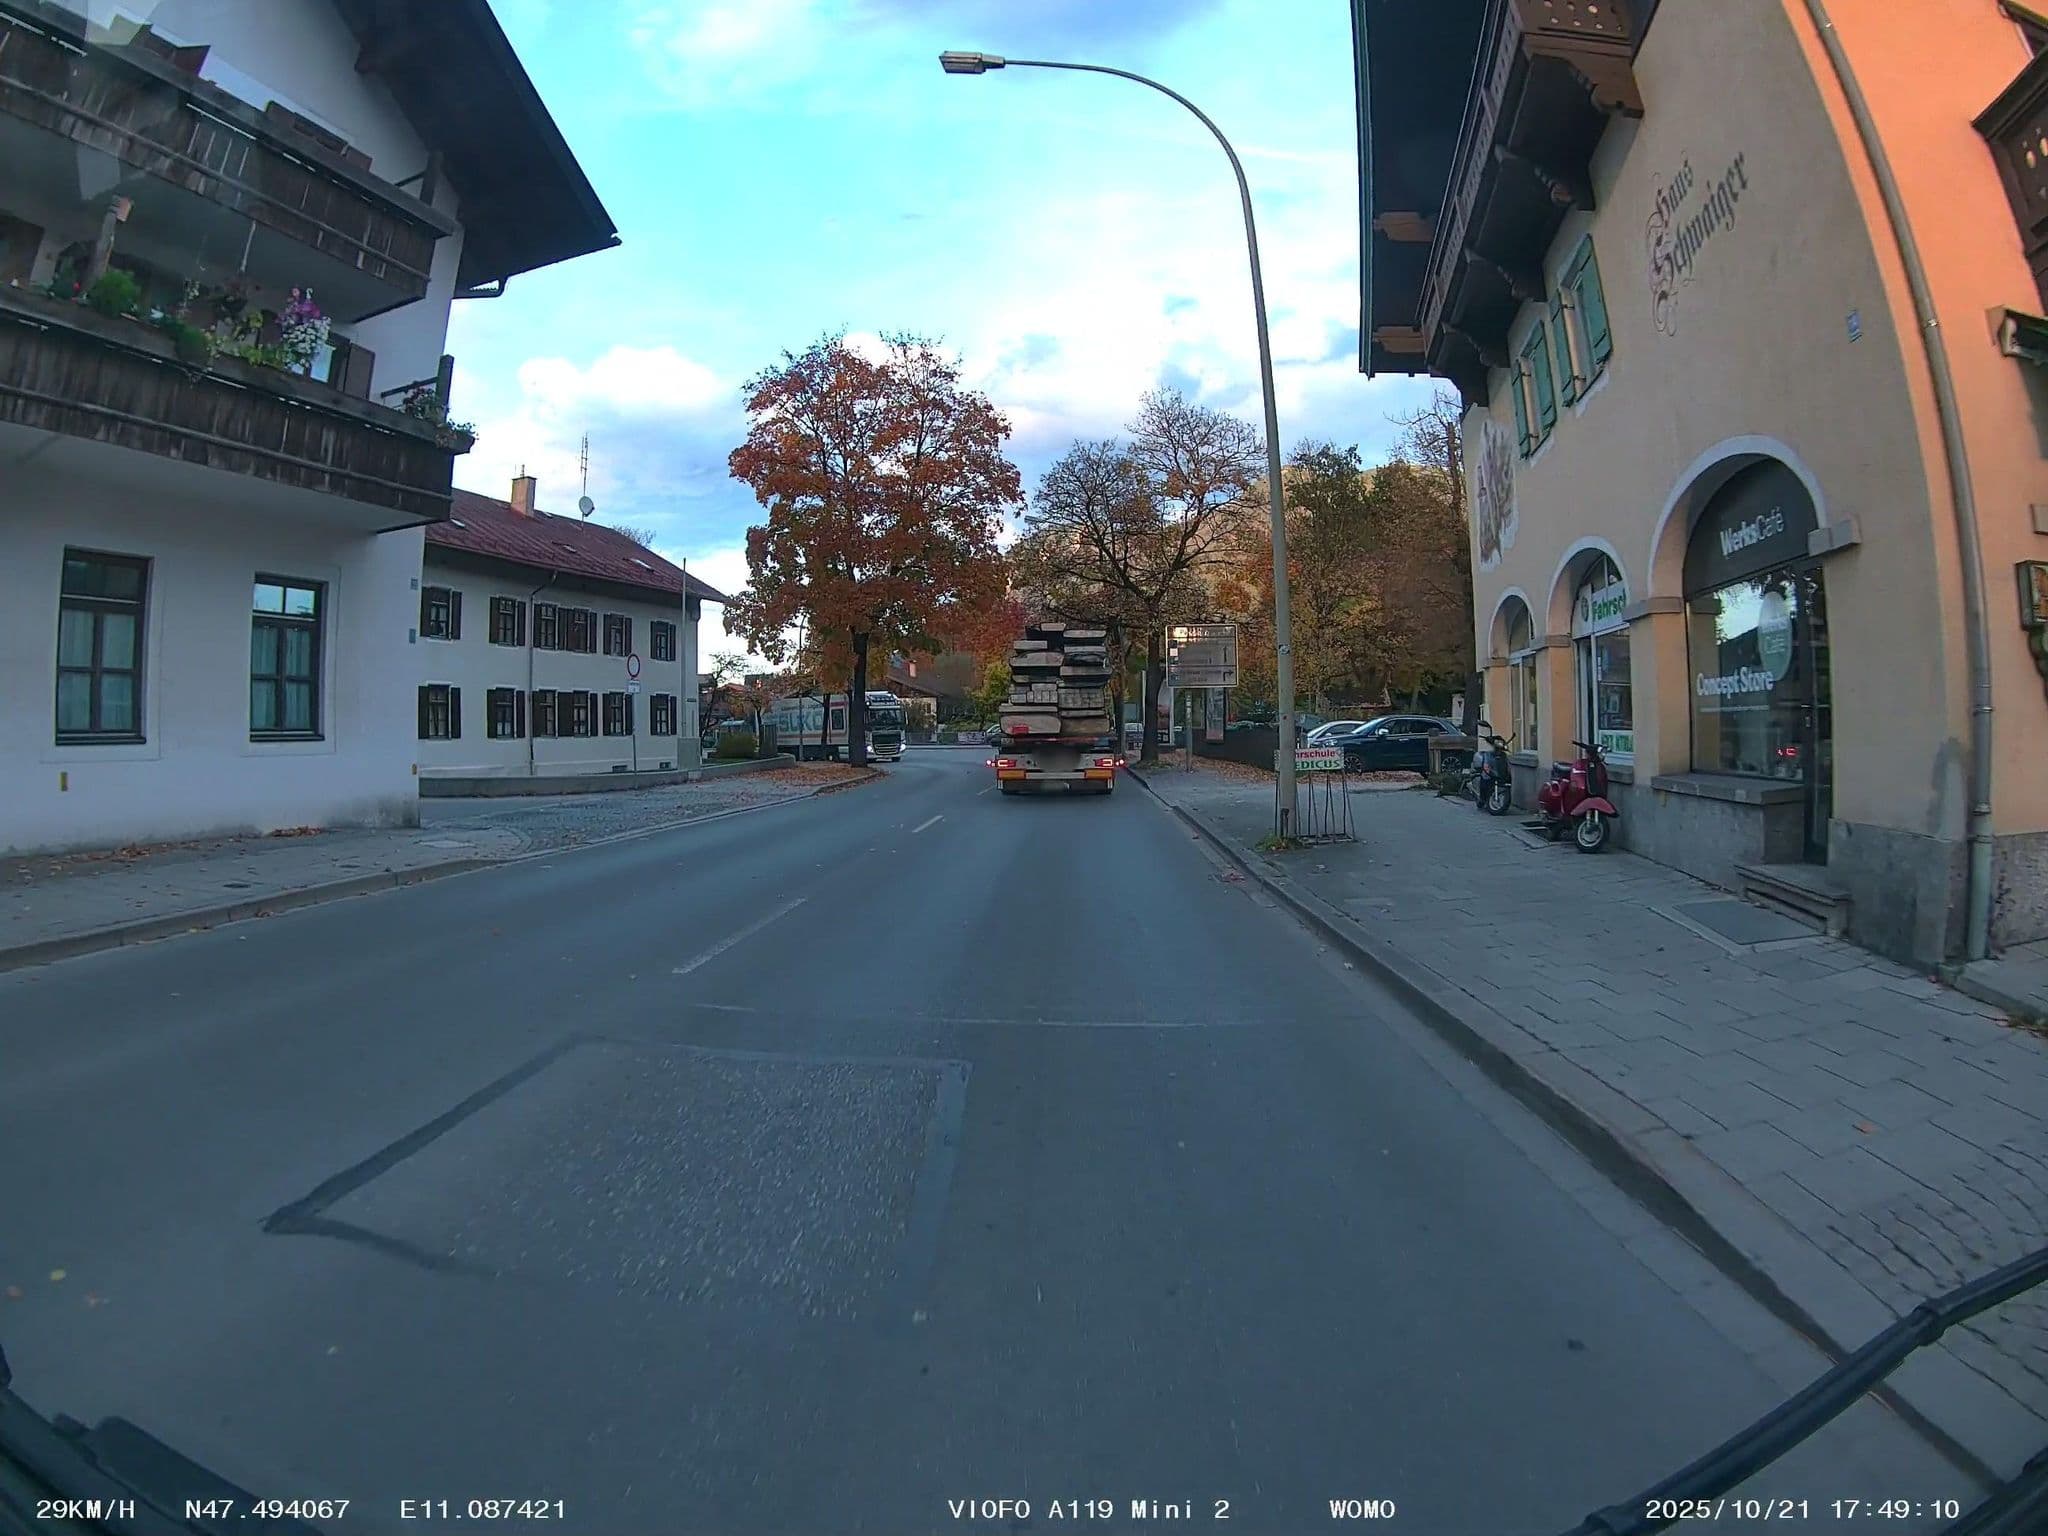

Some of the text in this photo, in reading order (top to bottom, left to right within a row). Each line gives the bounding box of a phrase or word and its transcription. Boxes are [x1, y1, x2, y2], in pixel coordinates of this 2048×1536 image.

[1648, 154, 1693, 232] Haus
[1696, 666, 1775, 699] Concept Store
